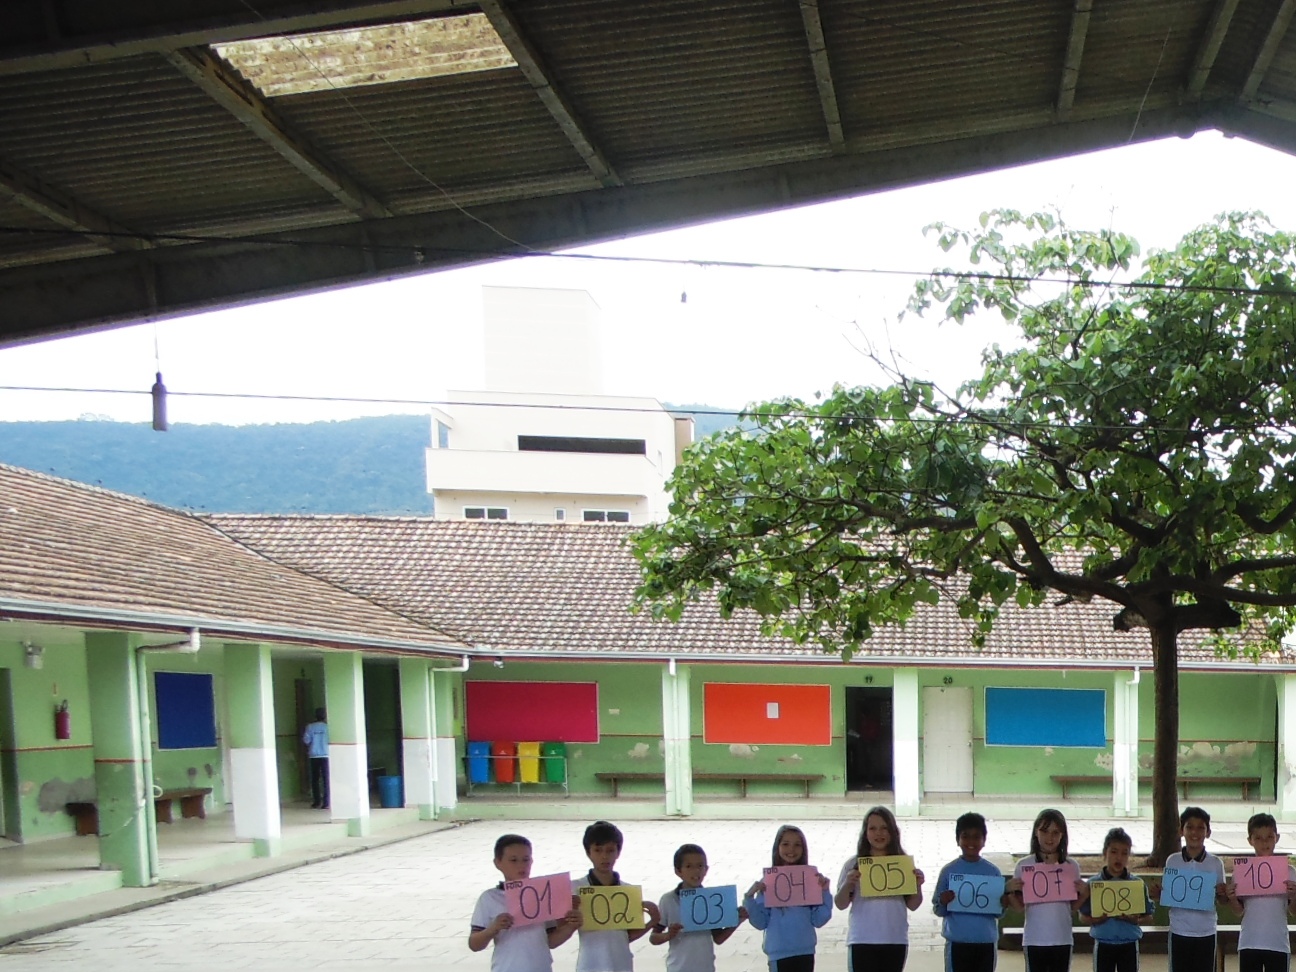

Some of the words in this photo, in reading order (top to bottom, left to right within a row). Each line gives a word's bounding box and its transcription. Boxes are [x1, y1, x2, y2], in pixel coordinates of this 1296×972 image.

[943, 676, 953, 684] 20
[858, 857, 874, 866] FOTO
[1164, 867, 1178, 875] FOTO
[1233, 857, 1248, 866] FOTO
[505, 881, 523, 889] FOTO
[774, 870, 806, 903] 04
[868, 862, 906, 892] 05
[950, 874, 964, 882] FOTO
[1032, 868, 1063, 898] 07
[1244, 861, 1274, 890] 10
[519, 881, 552, 920] 01
[579, 887, 595, 896] FOTO
[680, 888, 696, 898] FOTO
[957, 881, 989, 909] 06
[1100, 887, 1132, 913] 08
[1170, 875, 1204, 904] 09
[590, 892, 634, 925] 02
[691, 893, 724, 926] 03
